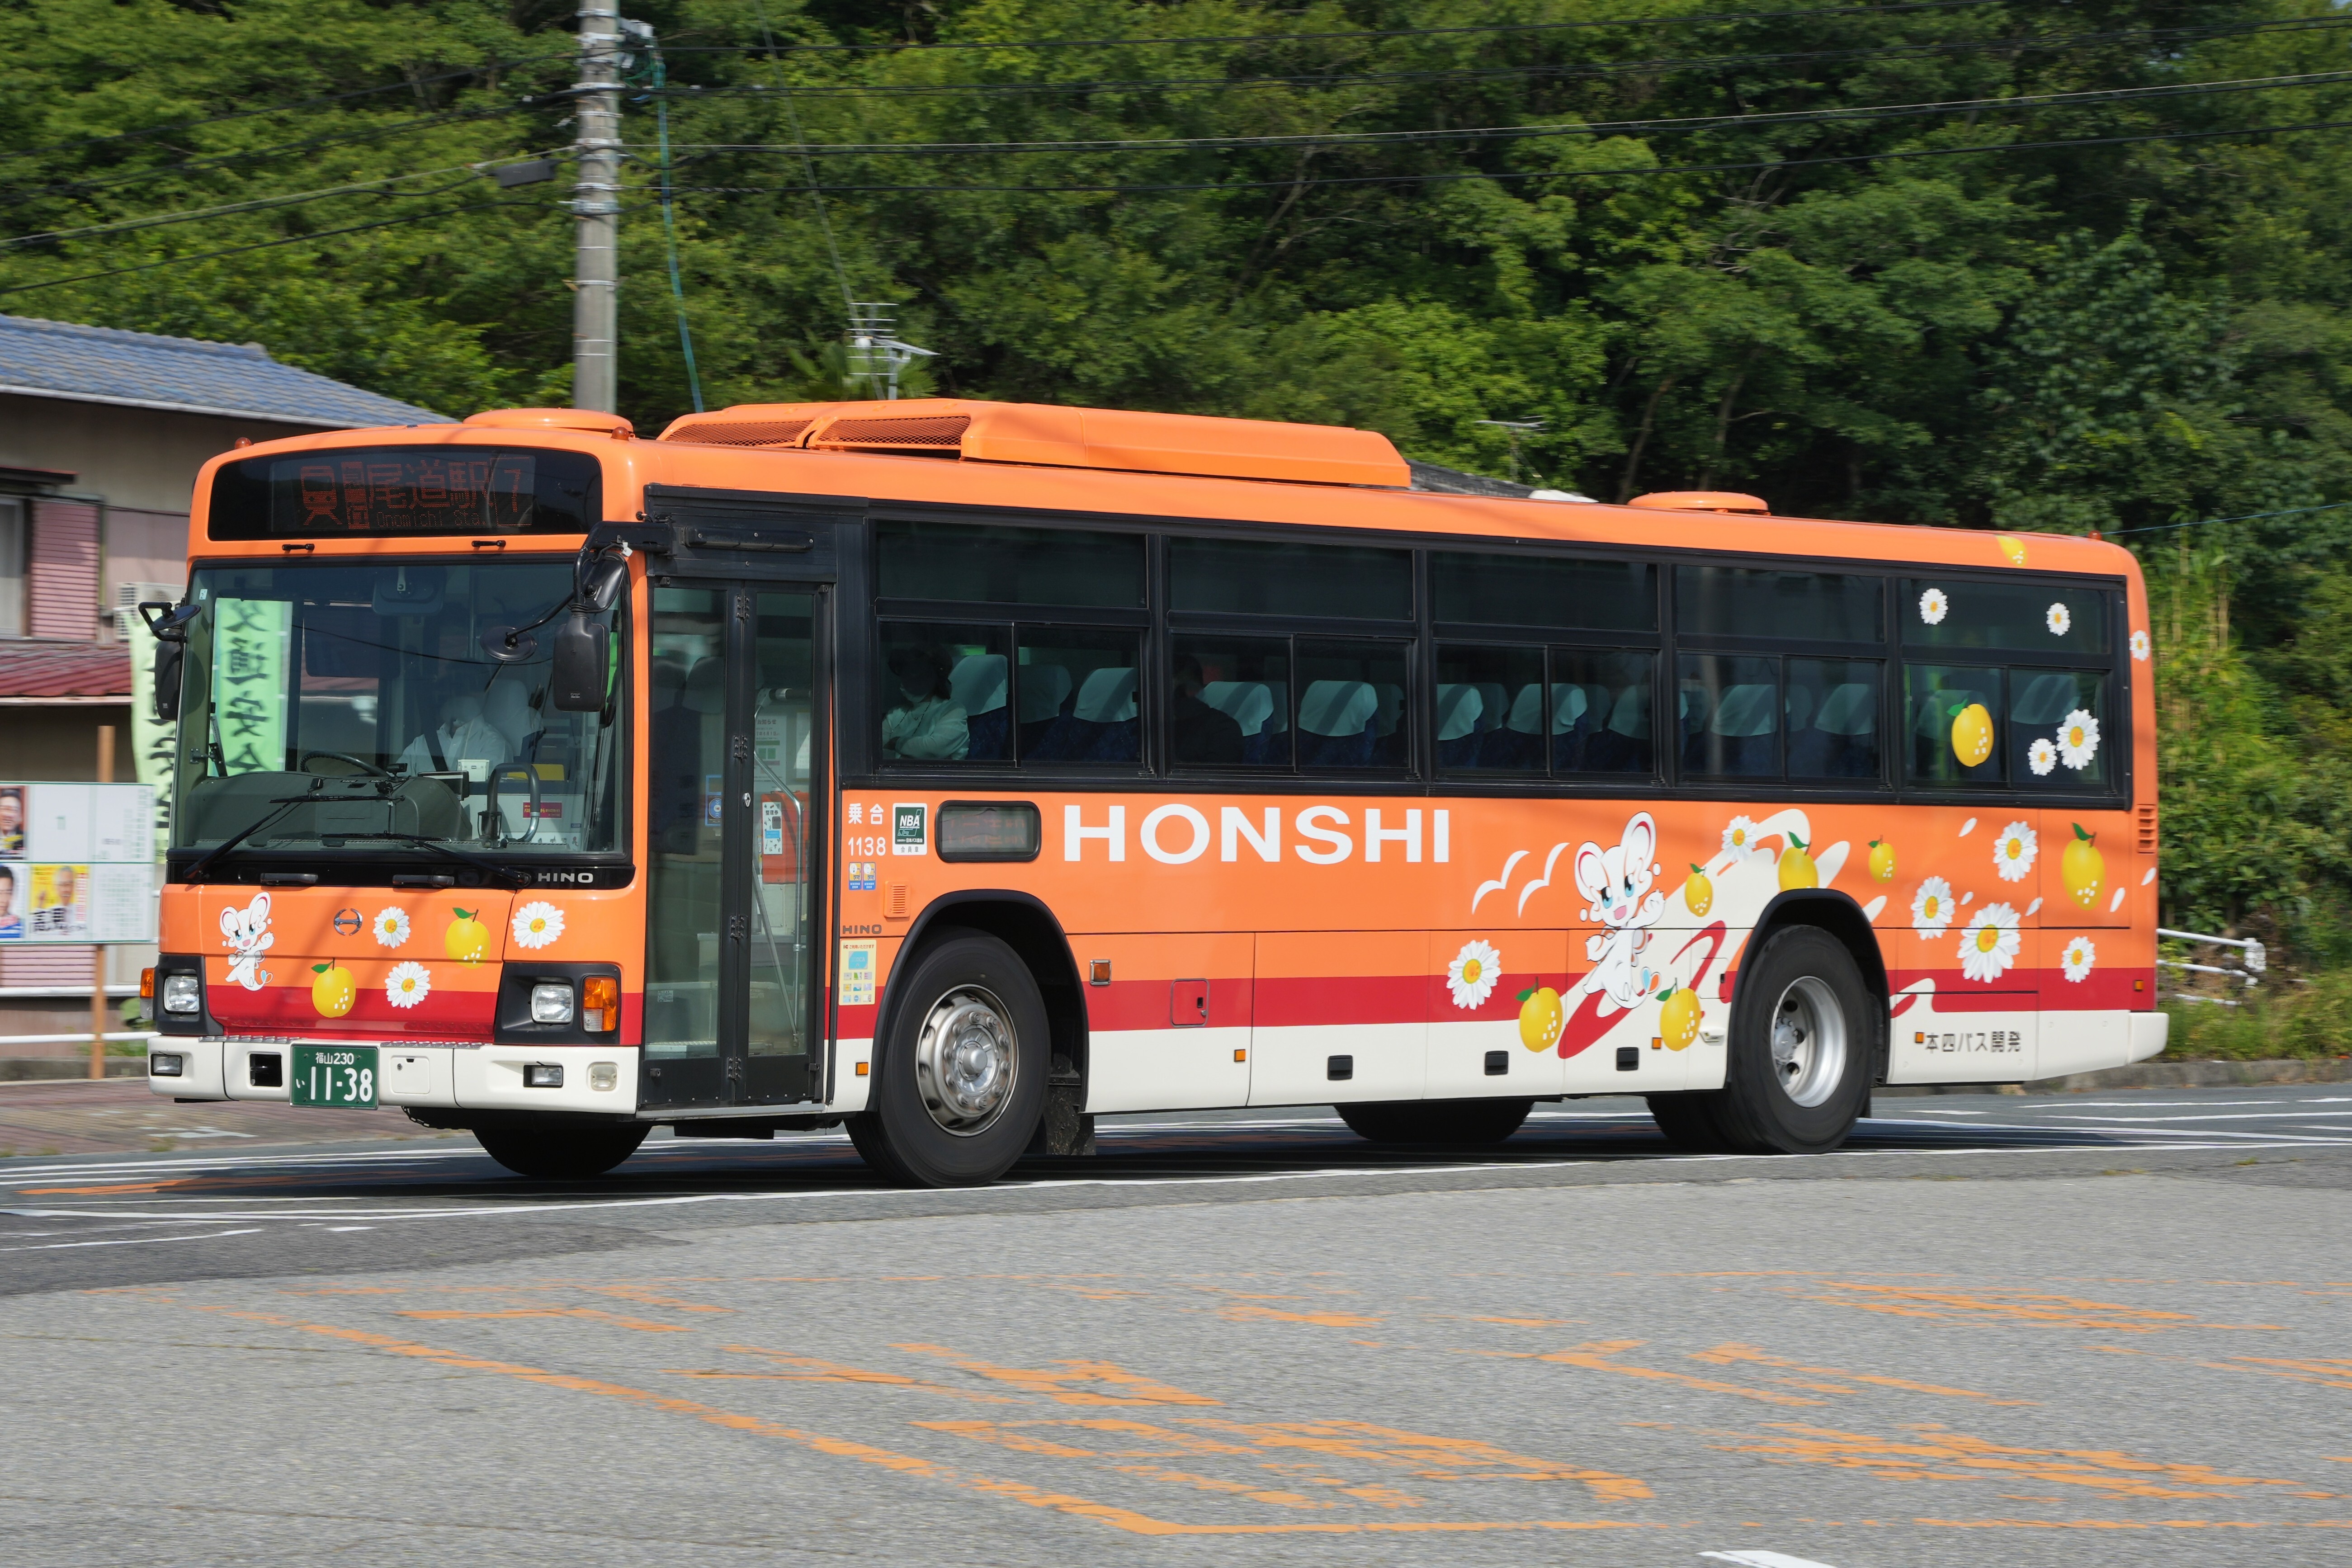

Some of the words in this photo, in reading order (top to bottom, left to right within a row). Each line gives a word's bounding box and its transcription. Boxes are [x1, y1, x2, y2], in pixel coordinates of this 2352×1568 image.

[366, 459, 494, 510] 尾道駅
[503, 469, 521, 512] 7
[376, 510, 443, 528] Onomichi
[453, 510, 487, 527] Sta.
[848, 803, 884, 825] 乗合
[899, 815, 920, 827] NBA
[1064, 803, 1450, 864] HONSHI
[848, 836, 886, 856] 1138
[538, 872, 594, 883] HINO
[842, 924, 882, 935] HINO
[1925, 1031, 2022, 1054] 本四バス開発
[315, 1052, 354, 1065] 福山230
[296, 1078, 305, 1089] い
[310, 1066, 373, 1102] 11-38
